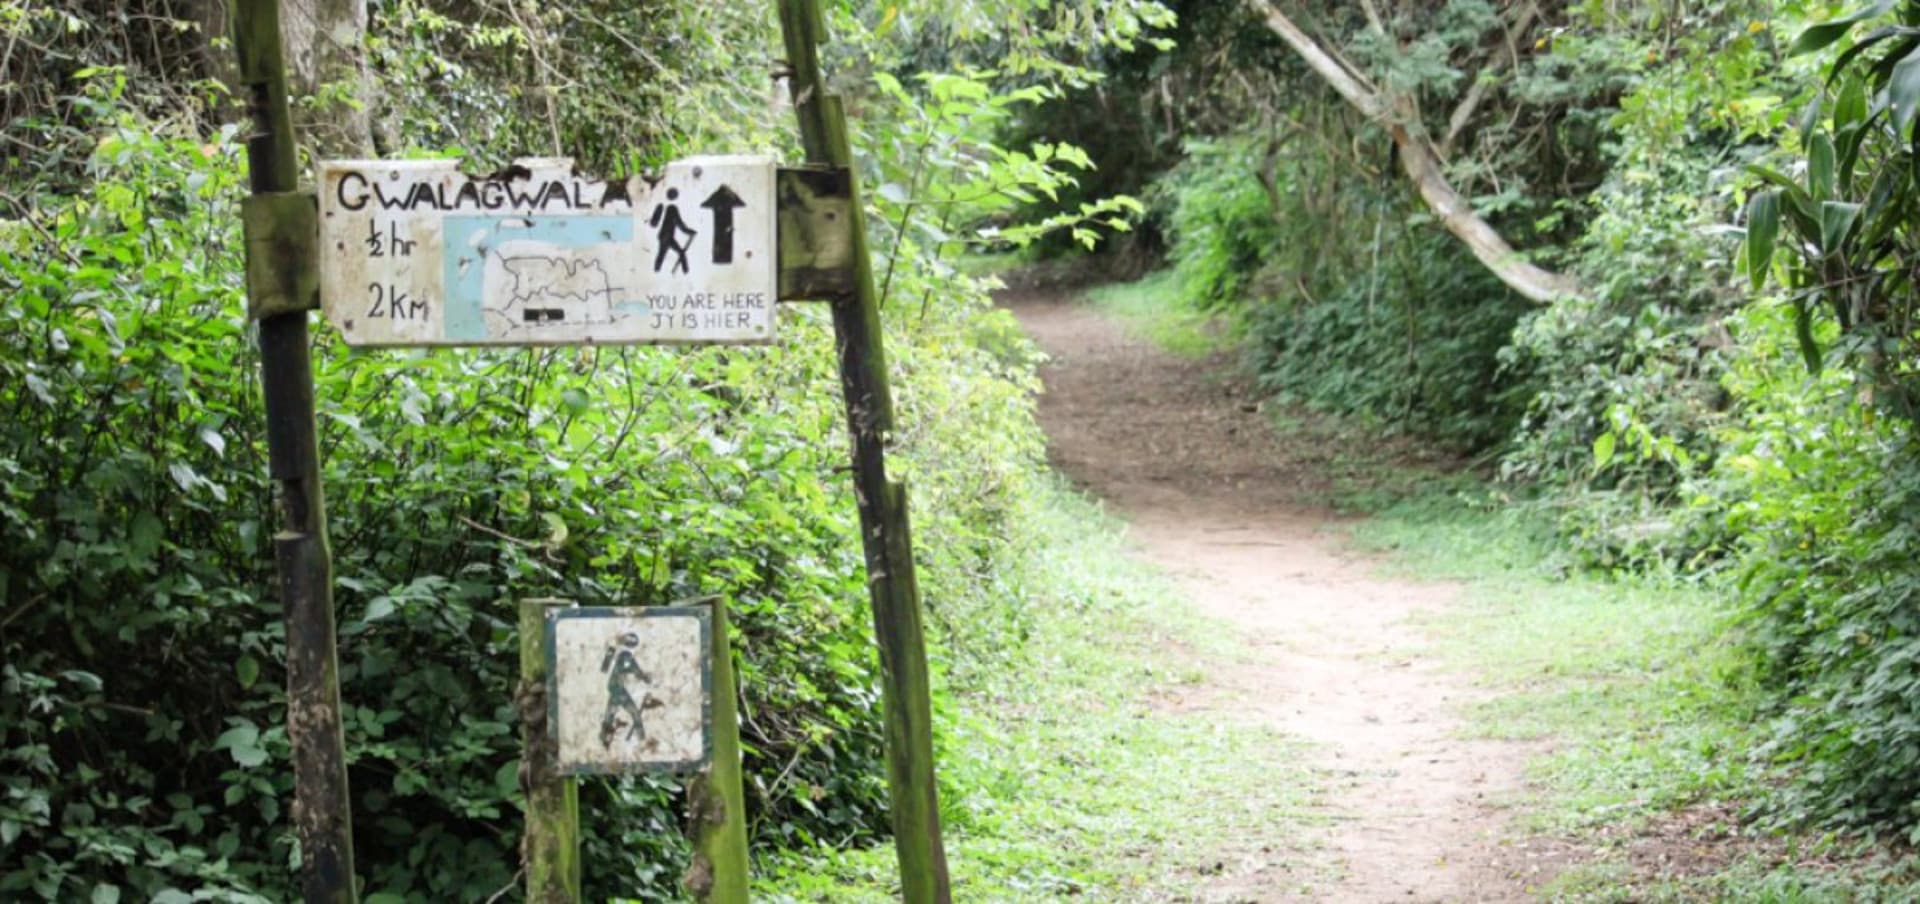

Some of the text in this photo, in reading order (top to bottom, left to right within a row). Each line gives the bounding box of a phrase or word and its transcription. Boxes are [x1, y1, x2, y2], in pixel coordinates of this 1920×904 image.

[337, 170, 632, 210] GWALAGWALA
[646, 292, 766, 310] YOU ARE HERE
[649, 311, 751, 329] JY IS HIER
